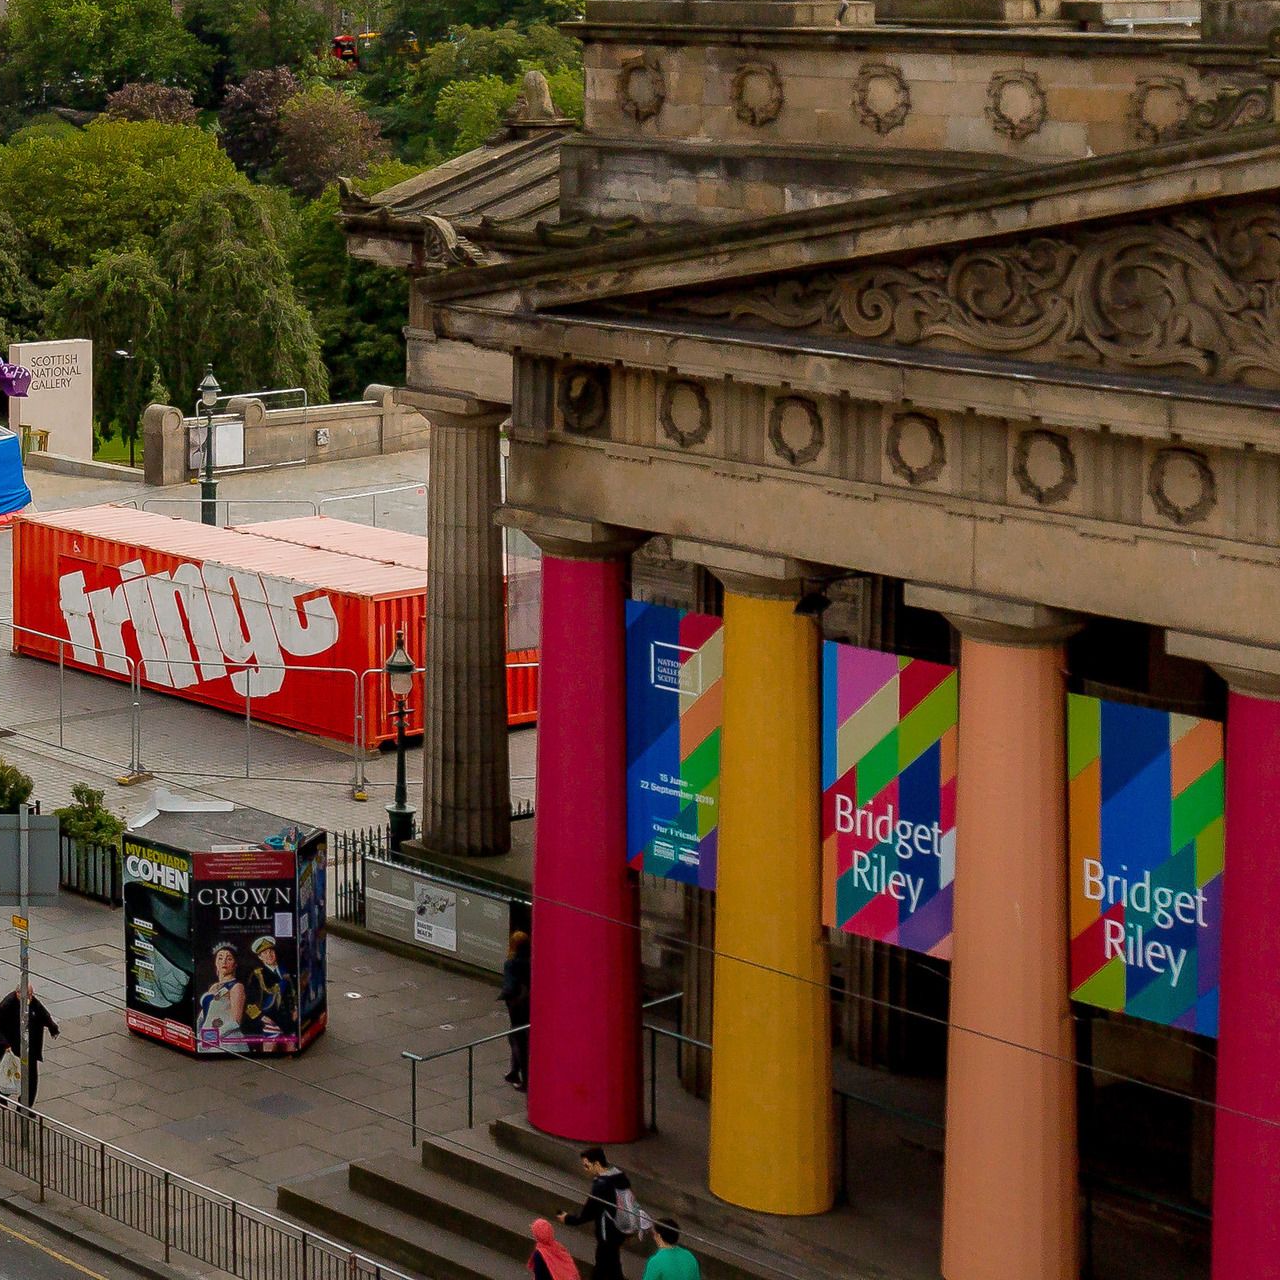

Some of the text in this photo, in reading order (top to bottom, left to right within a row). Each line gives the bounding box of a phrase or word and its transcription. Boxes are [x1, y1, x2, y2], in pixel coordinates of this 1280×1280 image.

[31, 354, 78, 366] SCOTTISH
[31, 366, 82, 378] NATIONAL
[31, 378, 72, 391] GALLERY
[640, 780, 714, 806] 22 September 2019
[670, 775, 688, 788] June
[835, 793, 942, 859] Bridget
[125, 842, 140, 858] MY
[142, 847, 188, 872] LEONARD
[126, 855, 190, 894] COHEN
[852, 850, 924, 913] Riley
[198, 887, 291, 906] CROWN
[1082, 857, 1208, 928] Bridget
[219, 906, 273, 920] DUAL
[1104, 918, 1187, 988] Riley
